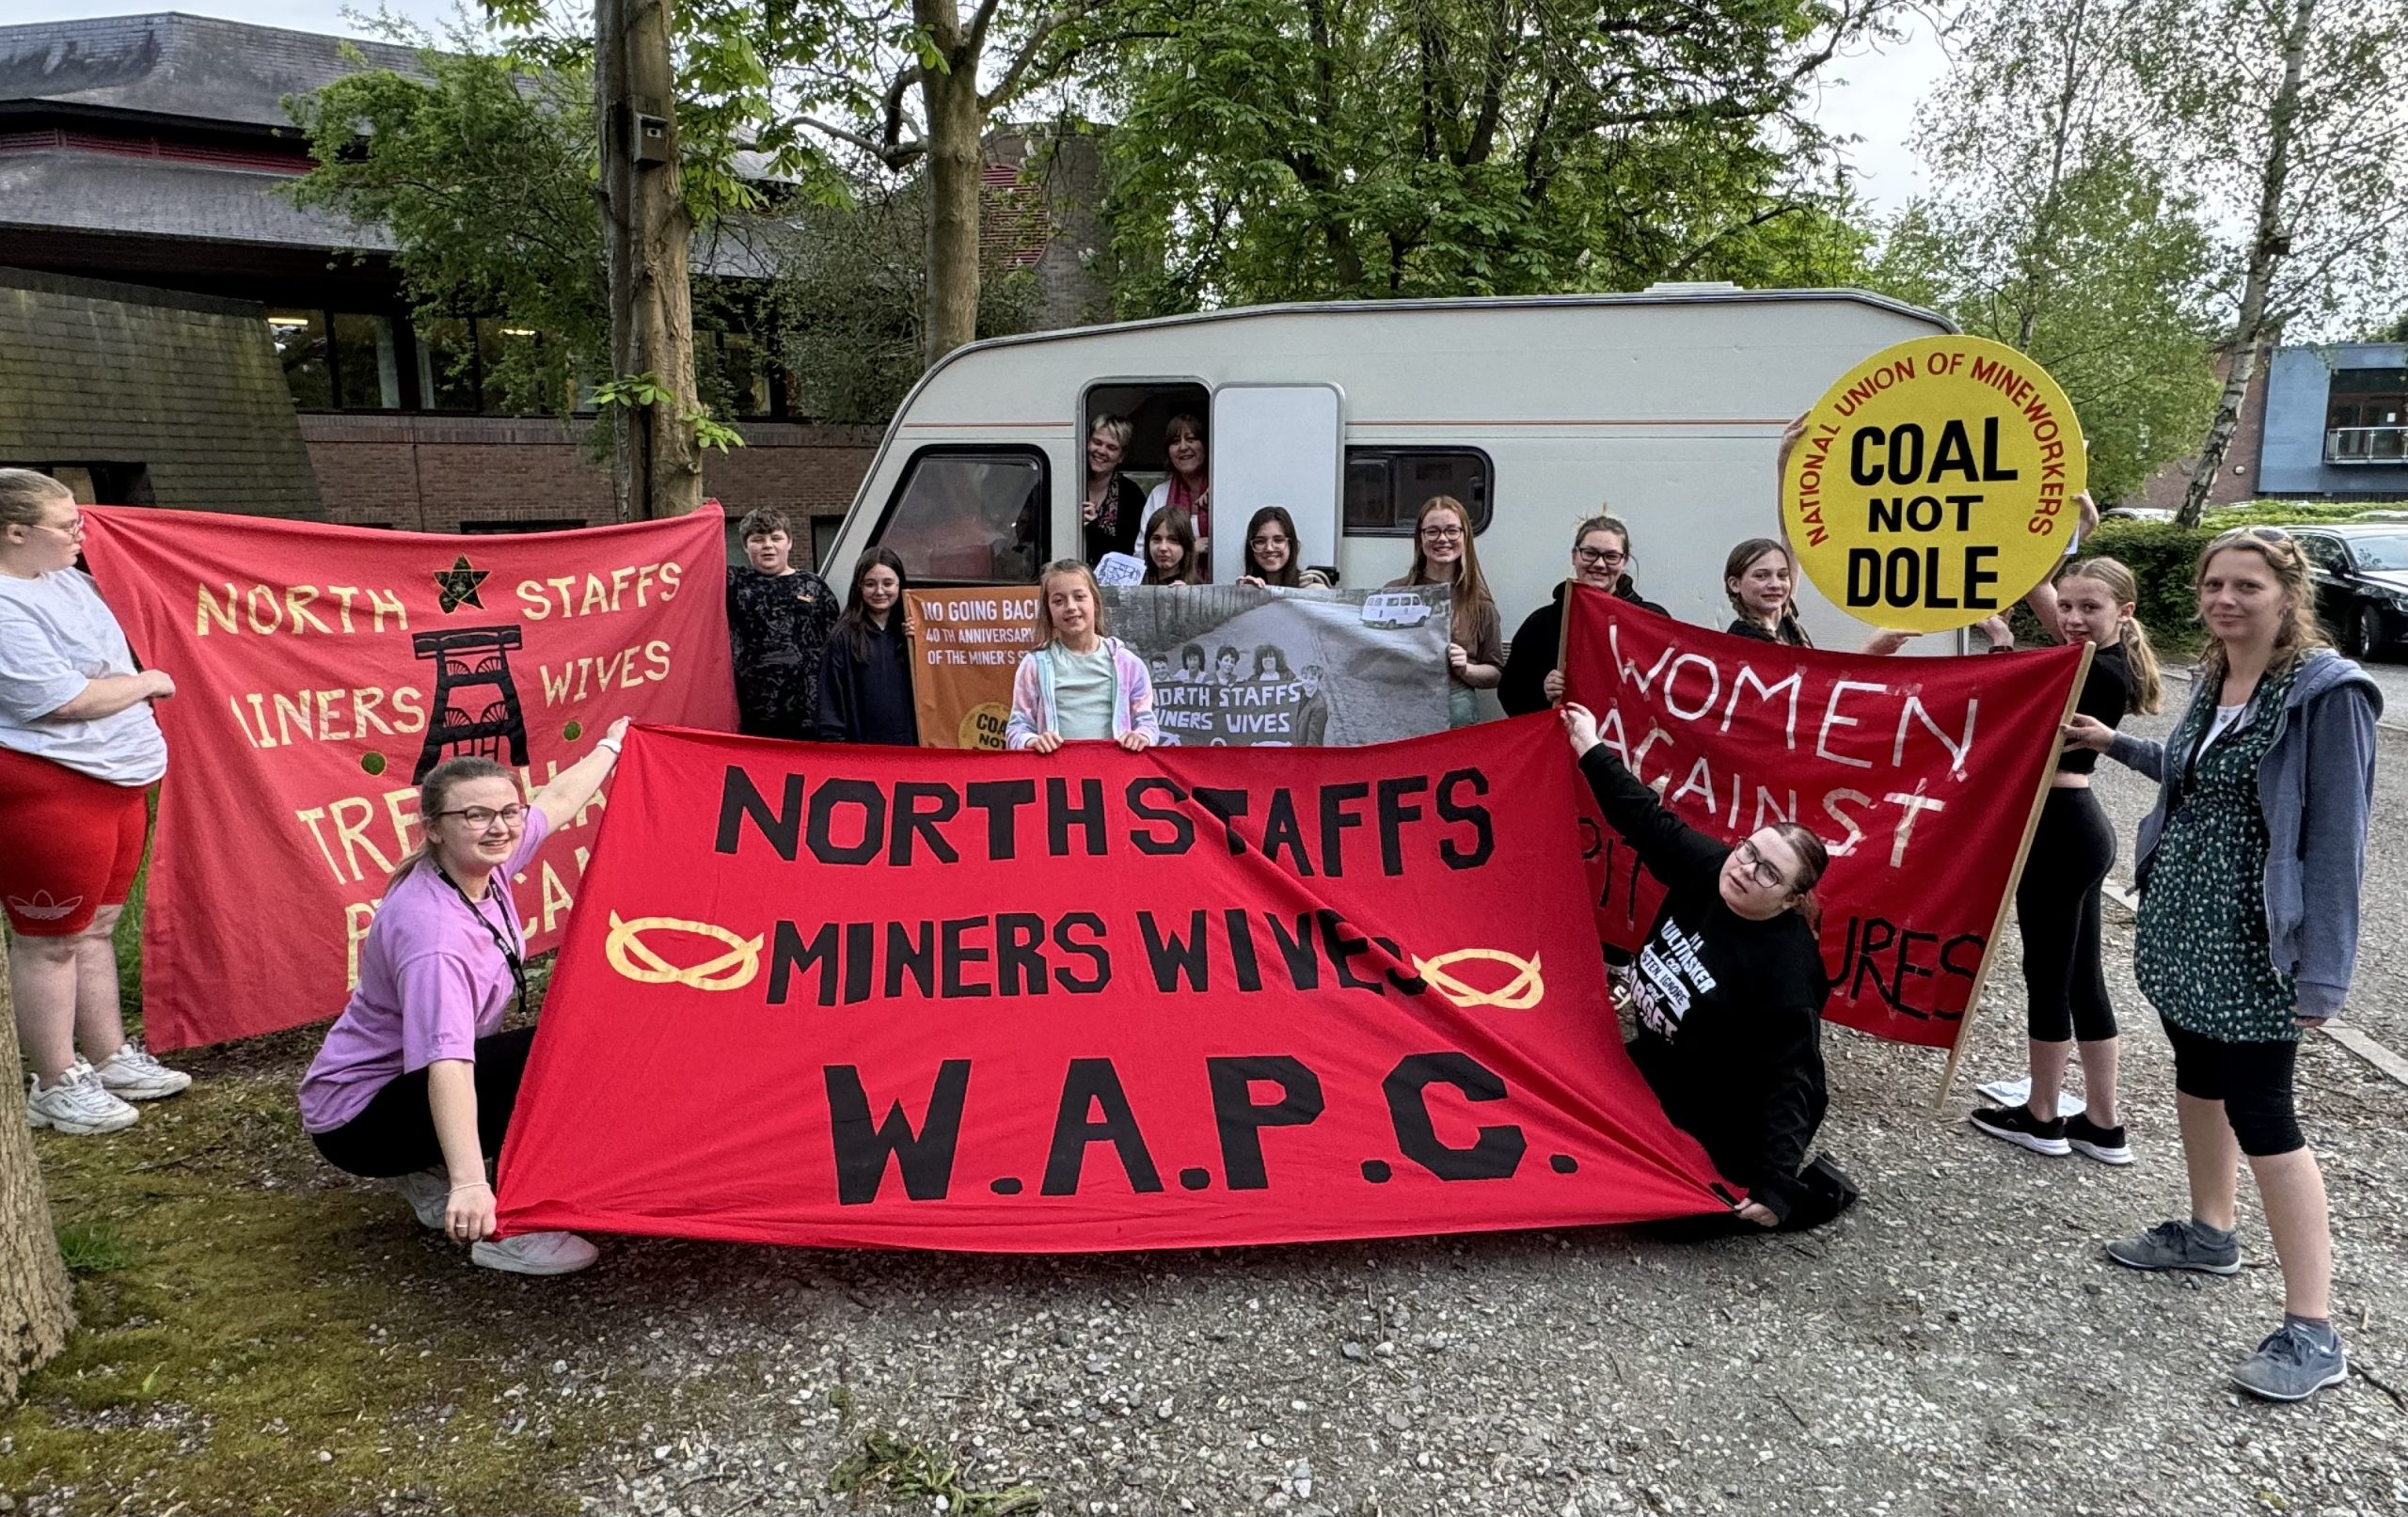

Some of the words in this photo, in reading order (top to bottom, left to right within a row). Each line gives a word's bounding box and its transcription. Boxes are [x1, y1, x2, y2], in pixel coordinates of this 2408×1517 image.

[1798, 423, 1841, 547] NATIONAL
[1833, 356, 1916, 418] UNION
[1927, 352, 1966, 376] OF
[1970, 355, 2067, 537] MINEWORKERS
[1850, 416, 2019, 486] COAL
[1867, 495, 1985, 533] NOT
[198, 581, 409, 636] NORTH
[515, 561, 683, 622] STAFFS
[1846, 545, 2000, 610] DOLE
[921, 601, 943, 622] NO
[948, 600, 997, 622] GOING
[926, 627, 941, 642] 40
[942, 628, 956, 642] TH
[539, 640, 672, 707] WIVES
[927, 650, 943, 665] OF
[944, 649, 968, 665] THE
[969, 649, 1015, 665] MINER'S
[976, 713, 1008, 738] COA
[1219, 681, 1303, 707] STAFFS
[1226, 712, 1291, 734] WIVES
[1608, 620, 1979, 775] WOMEN
[714, 764, 1109, 867] NORTH
[1125, 766, 1496, 877] STAFFS
[766, 911, 1113, 1006] MINERS
[1135, 908, 1427, 997] WIVES
[1658, 973, 1687, 1006] IGNORE
[822, 1051, 1579, 1207] W.A.P.C.
